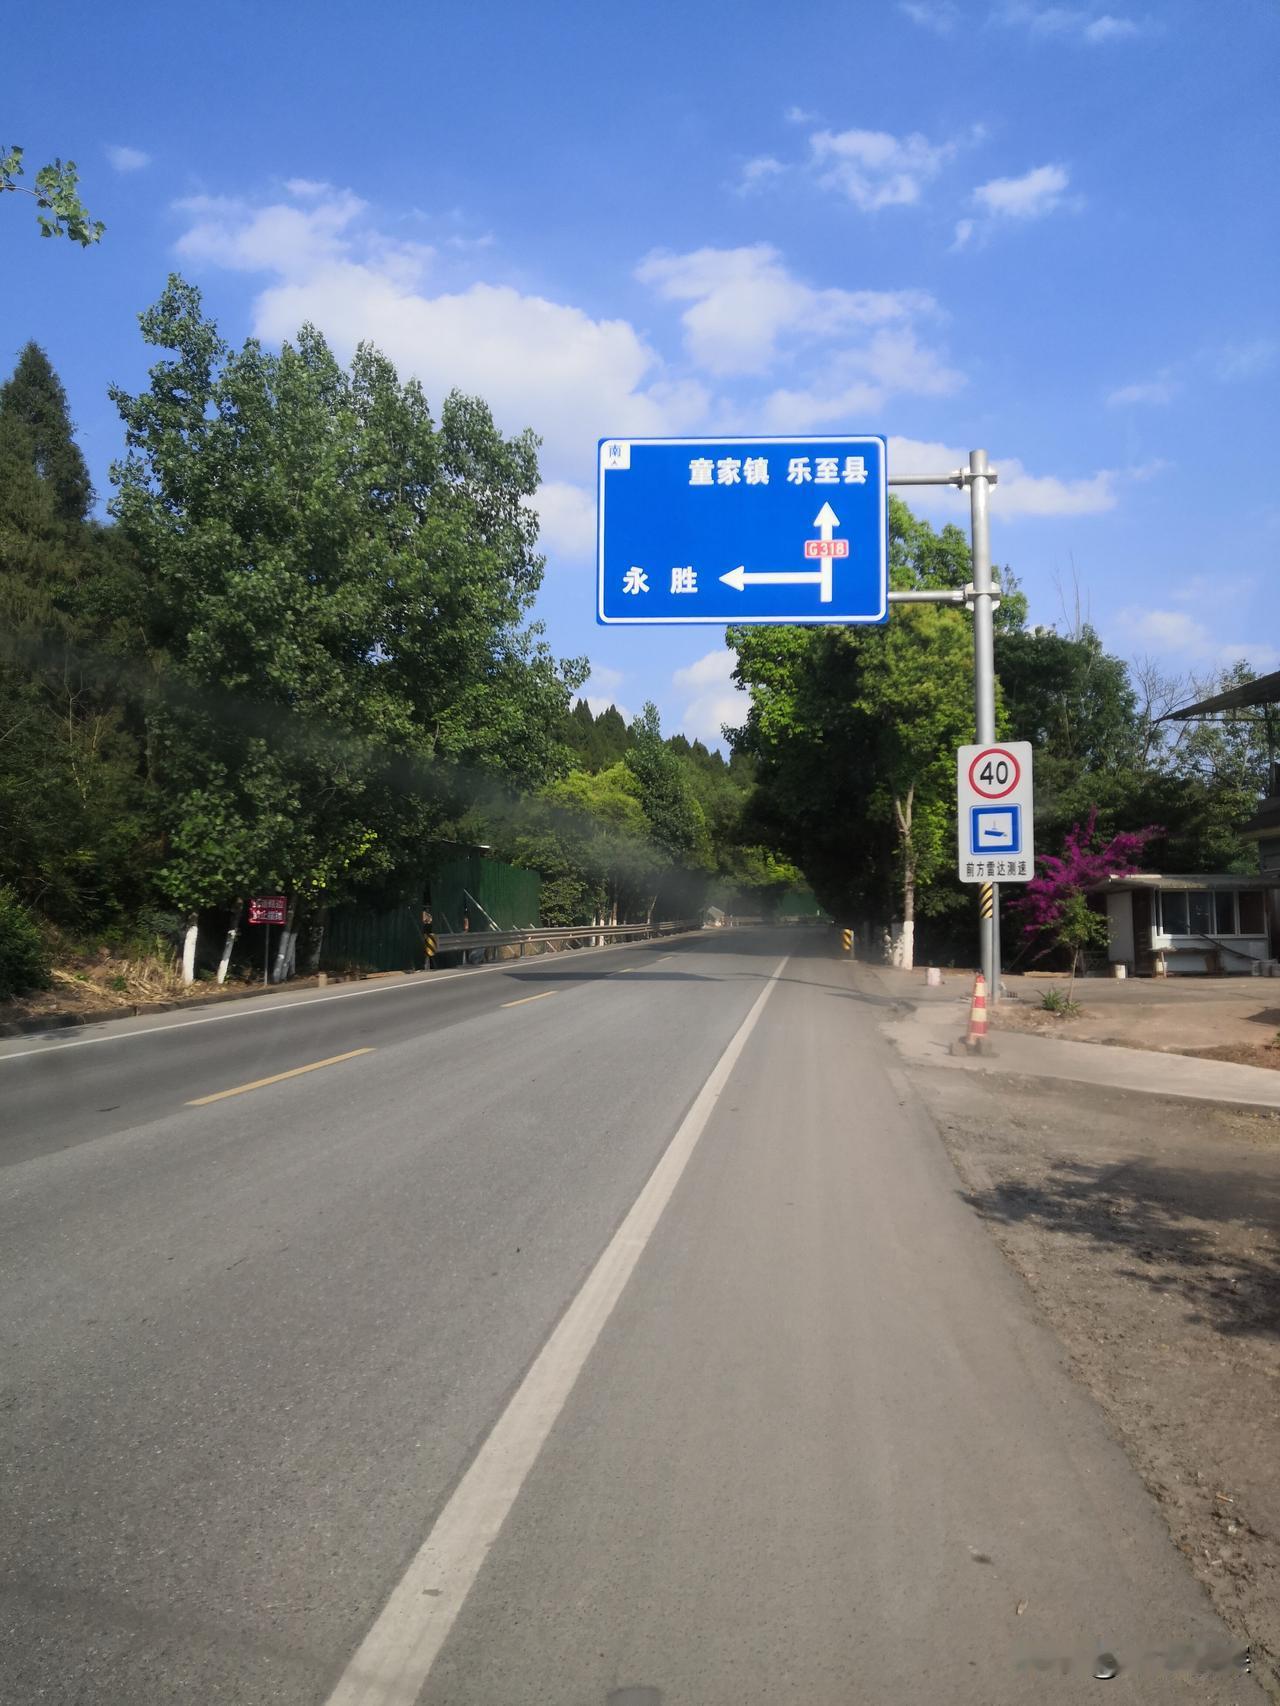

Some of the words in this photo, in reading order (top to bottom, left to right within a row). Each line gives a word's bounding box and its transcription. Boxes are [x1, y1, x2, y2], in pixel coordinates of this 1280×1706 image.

[608, 444, 622, 457] 南
[688, 457, 770, 486] 童家镇
[787, 456, 868, 485] 乐至县
[807, 542, 845, 556] G318
[979, 761, 1008, 785] 40
[966, 861, 1027, 877] 前方雷达测速
